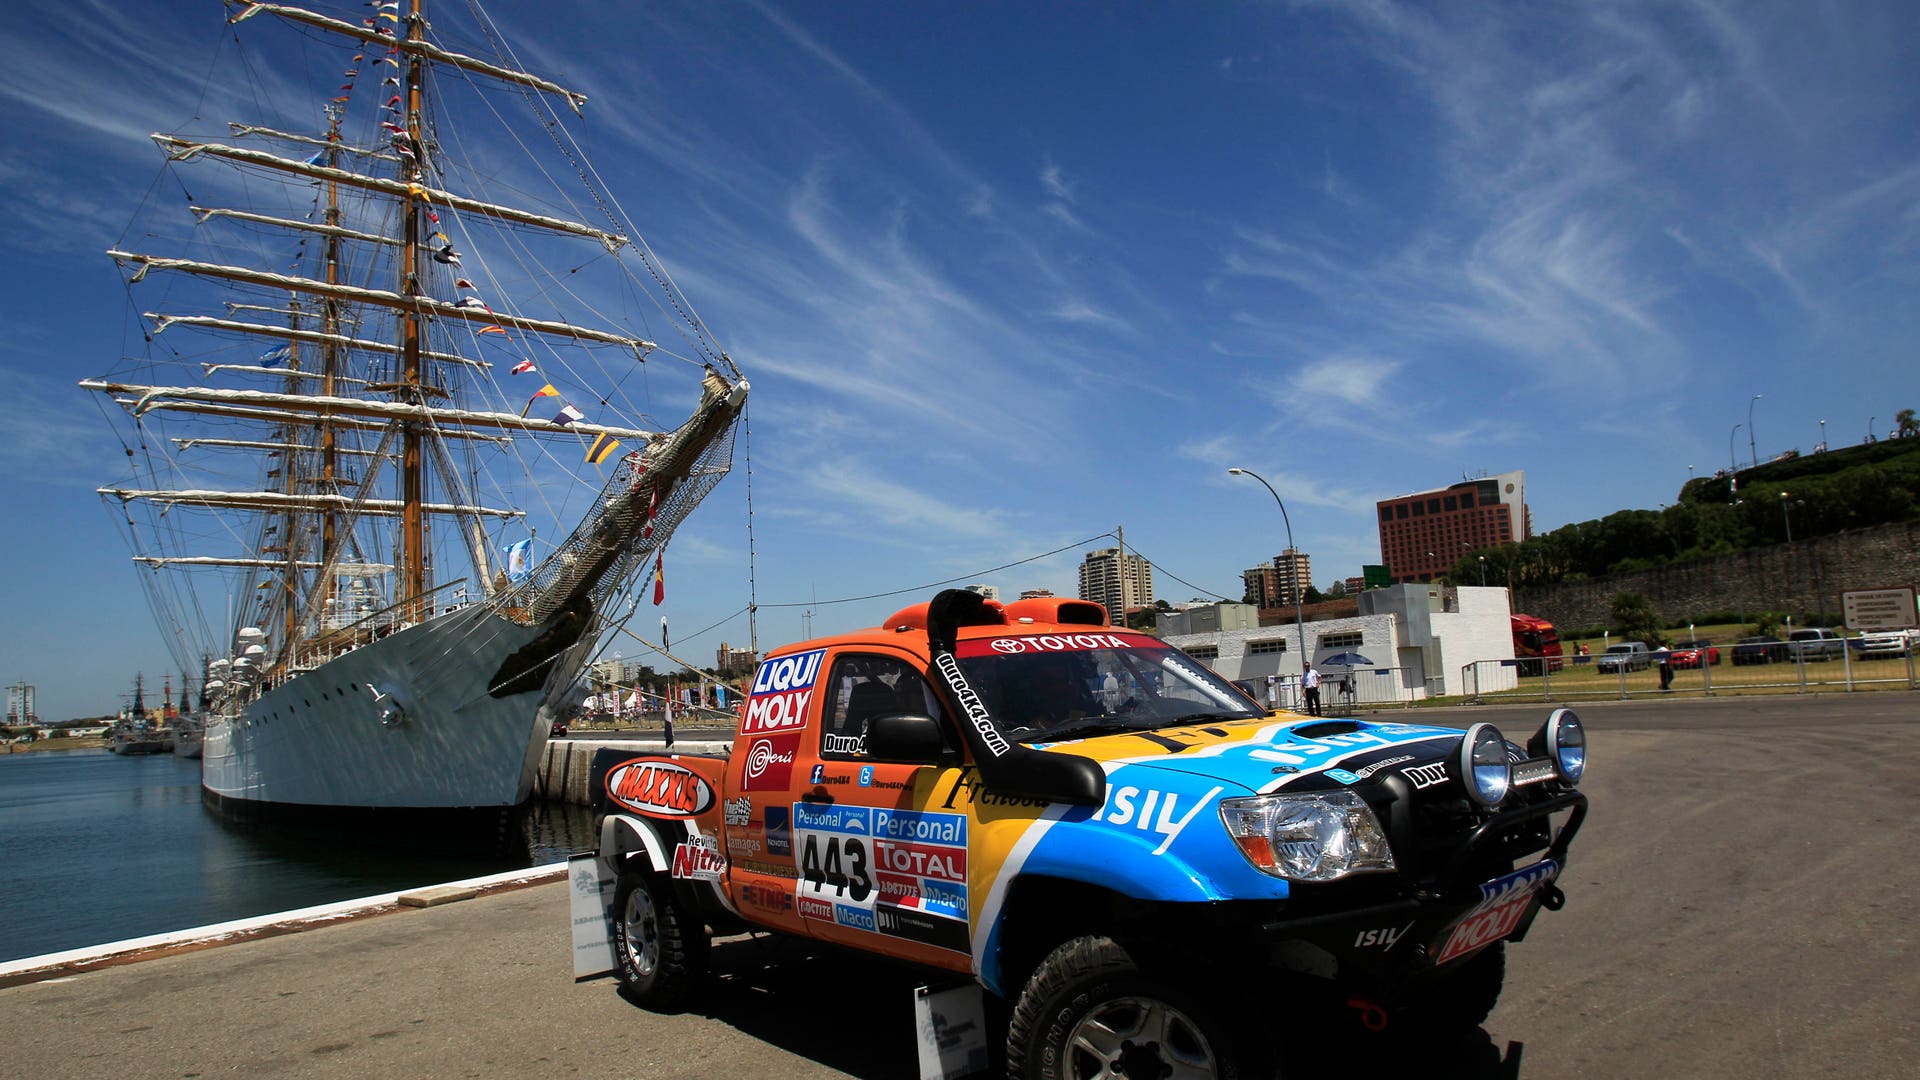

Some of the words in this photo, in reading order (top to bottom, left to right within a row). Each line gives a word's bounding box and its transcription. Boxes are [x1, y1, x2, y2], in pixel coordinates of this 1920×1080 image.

[1021, 635, 1132, 651] TOYOTA
[753, 652, 822, 693] LIQUI
[745, 690, 812, 730] MOLY
[824, 733, 868, 753] Duro4
[616, 765, 699, 813] MAXXIS
[1400, 762, 1450, 790] Dur
[798, 808, 842, 827] Personal
[876, 811, 962, 842] Personal
[767, 838, 790, 848] NOVOTEL
[673, 845, 726, 877] Nitro
[802, 834, 872, 902] 443
[876, 841, 963, 880] TOTAL
[926, 886, 966, 911] Macro
[837, 907, 873, 929] Macro
[1444, 901, 1526, 956] MOLY
